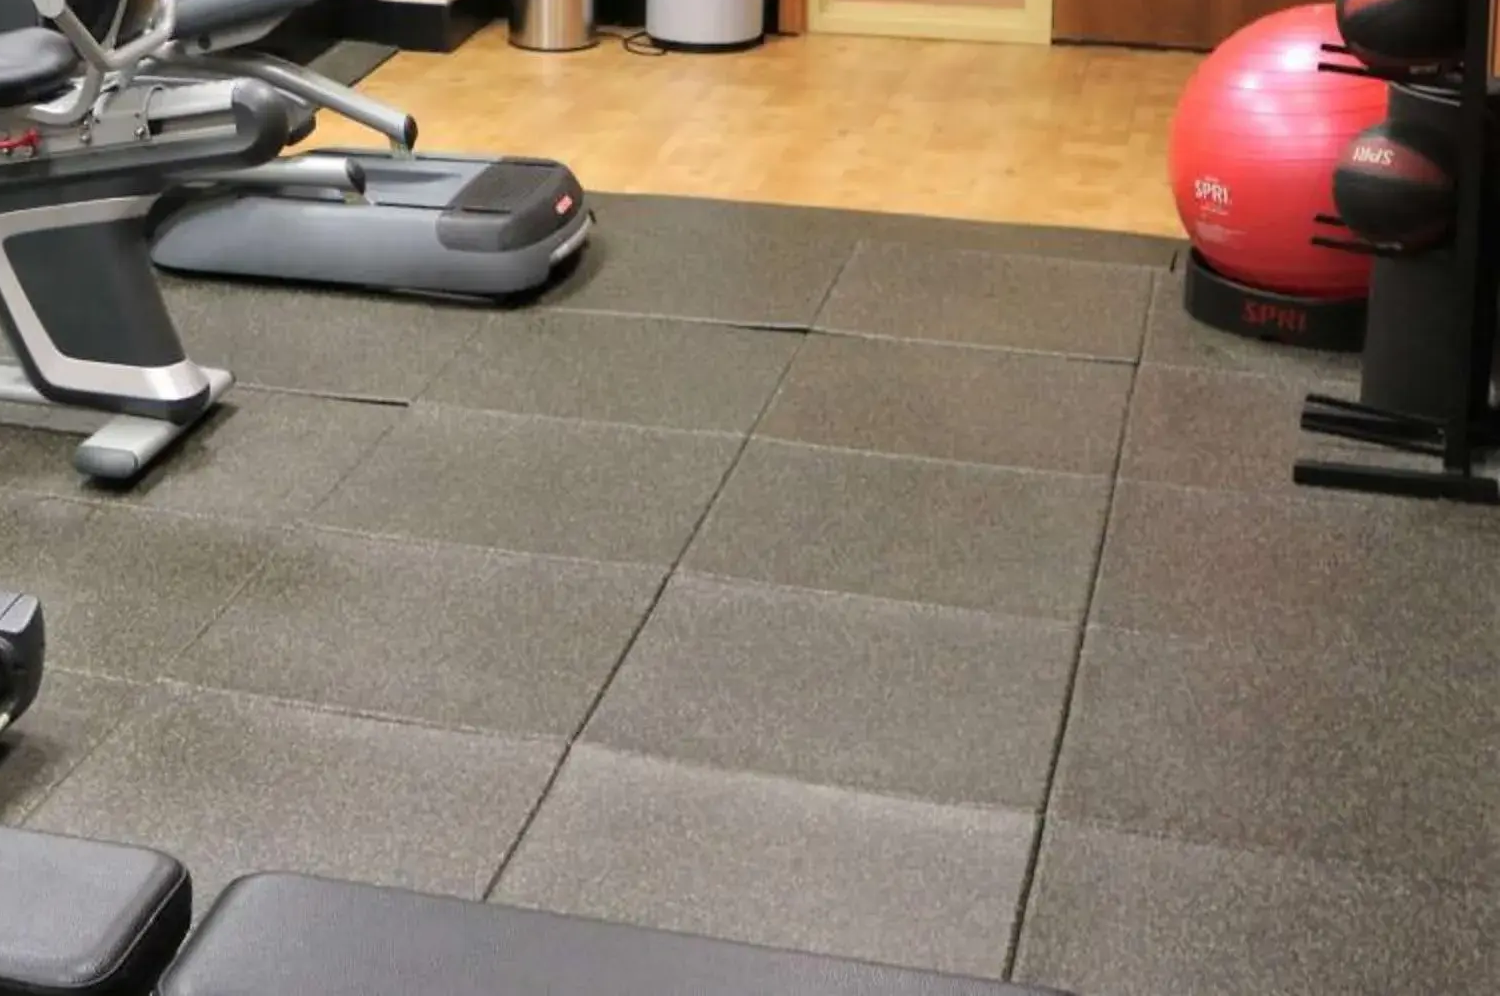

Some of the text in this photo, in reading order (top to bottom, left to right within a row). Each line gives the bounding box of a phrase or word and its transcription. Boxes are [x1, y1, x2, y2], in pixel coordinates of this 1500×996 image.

[1352, 146, 1395, 164] SPRI
[1194, 179, 1229, 205] SPRI
[1242, 299, 1307, 333] SPRI
